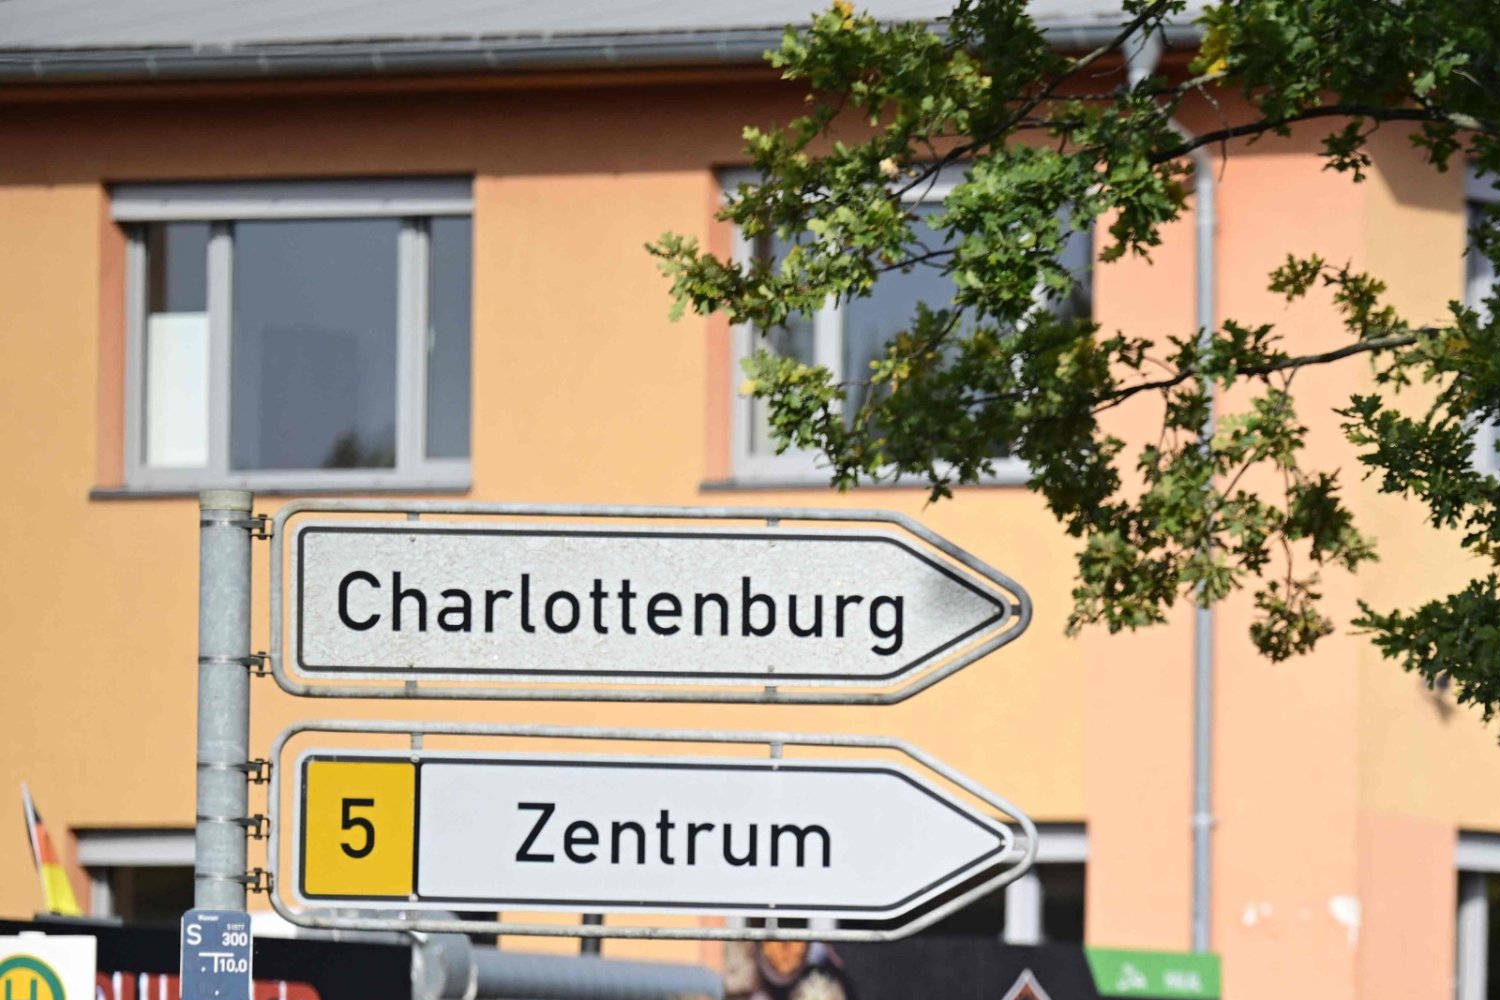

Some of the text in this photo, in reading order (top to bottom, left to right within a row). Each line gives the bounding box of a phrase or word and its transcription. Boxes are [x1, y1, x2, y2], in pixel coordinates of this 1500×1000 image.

[337, 570, 905, 656] Charlottenburg
[340, 798, 376, 859] 5
[515, 802, 831, 868] Zentrum
[187, 923, 202, 946] S
[222, 931, 249, 947] 300
